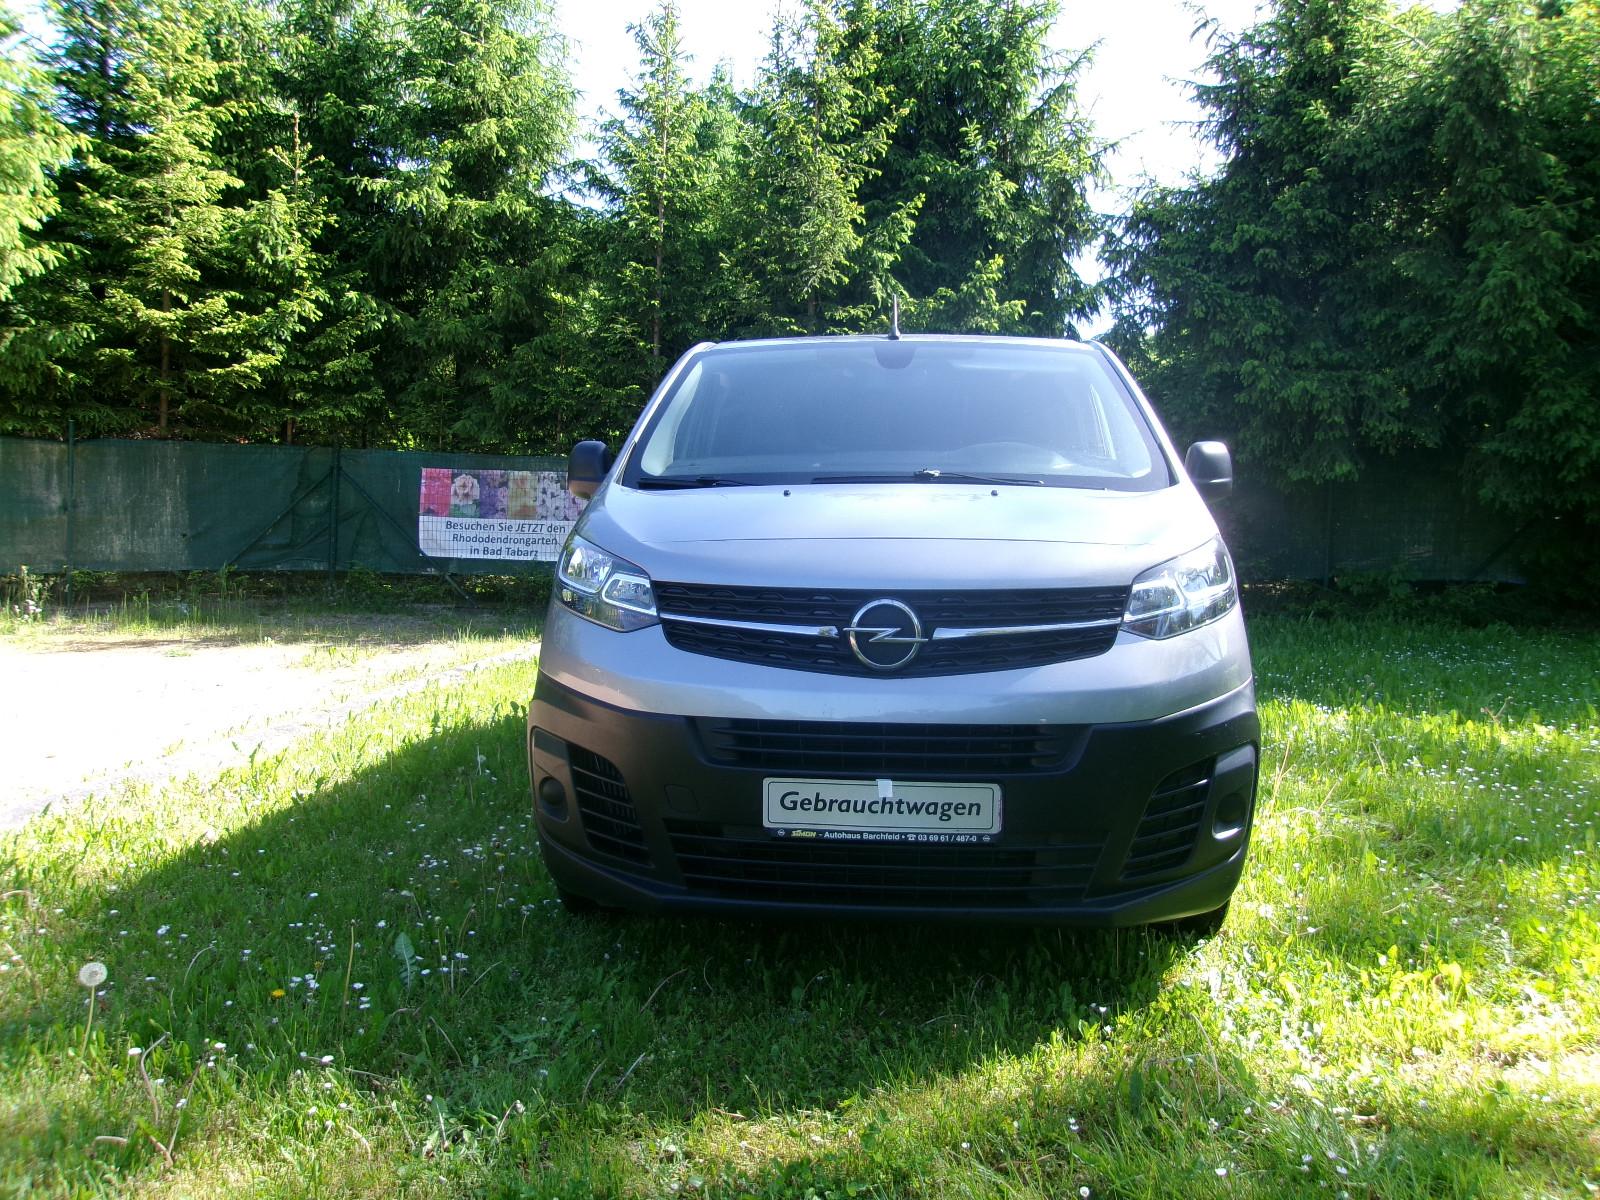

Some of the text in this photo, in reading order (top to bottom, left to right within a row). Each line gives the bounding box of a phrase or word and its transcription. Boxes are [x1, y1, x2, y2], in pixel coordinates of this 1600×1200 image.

[445, 521, 566, 533] Besuchen Sie JETZT den
[452, 533, 558, 547] Rhododendrongarten
[470, 546, 538, 557] in Bad Tabarz
[779, 790, 982, 822] Gebrauchtwagen
[823, 831, 861, 840] Autohaus
[862, 832, 900, 841] Barchfeld
[929, 834, 939, 842] 69
[940, 834, 949, 842] 61
